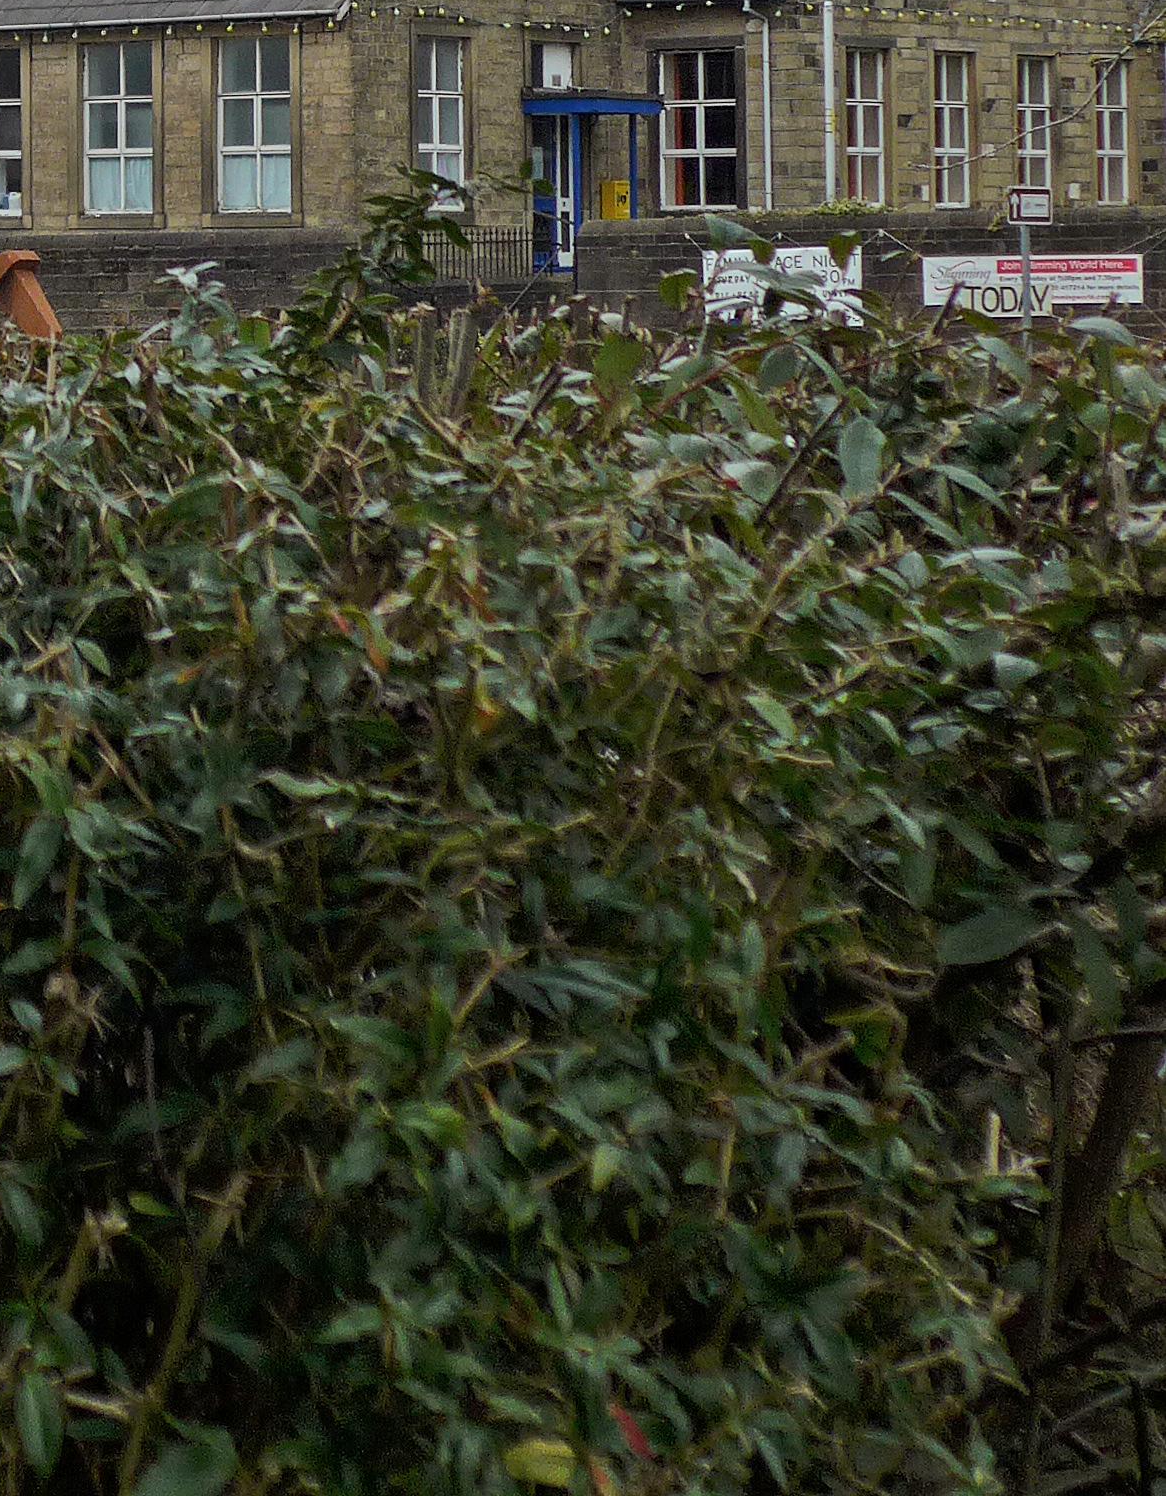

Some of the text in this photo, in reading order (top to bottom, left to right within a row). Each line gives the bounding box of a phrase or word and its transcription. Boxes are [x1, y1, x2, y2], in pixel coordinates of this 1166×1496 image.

[775, 255, 803, 269] ACE
[1001, 261, 1022, 271] Join
[1030, 261, 1068, 272] limming
[1069, 261, 1098, 270] World
